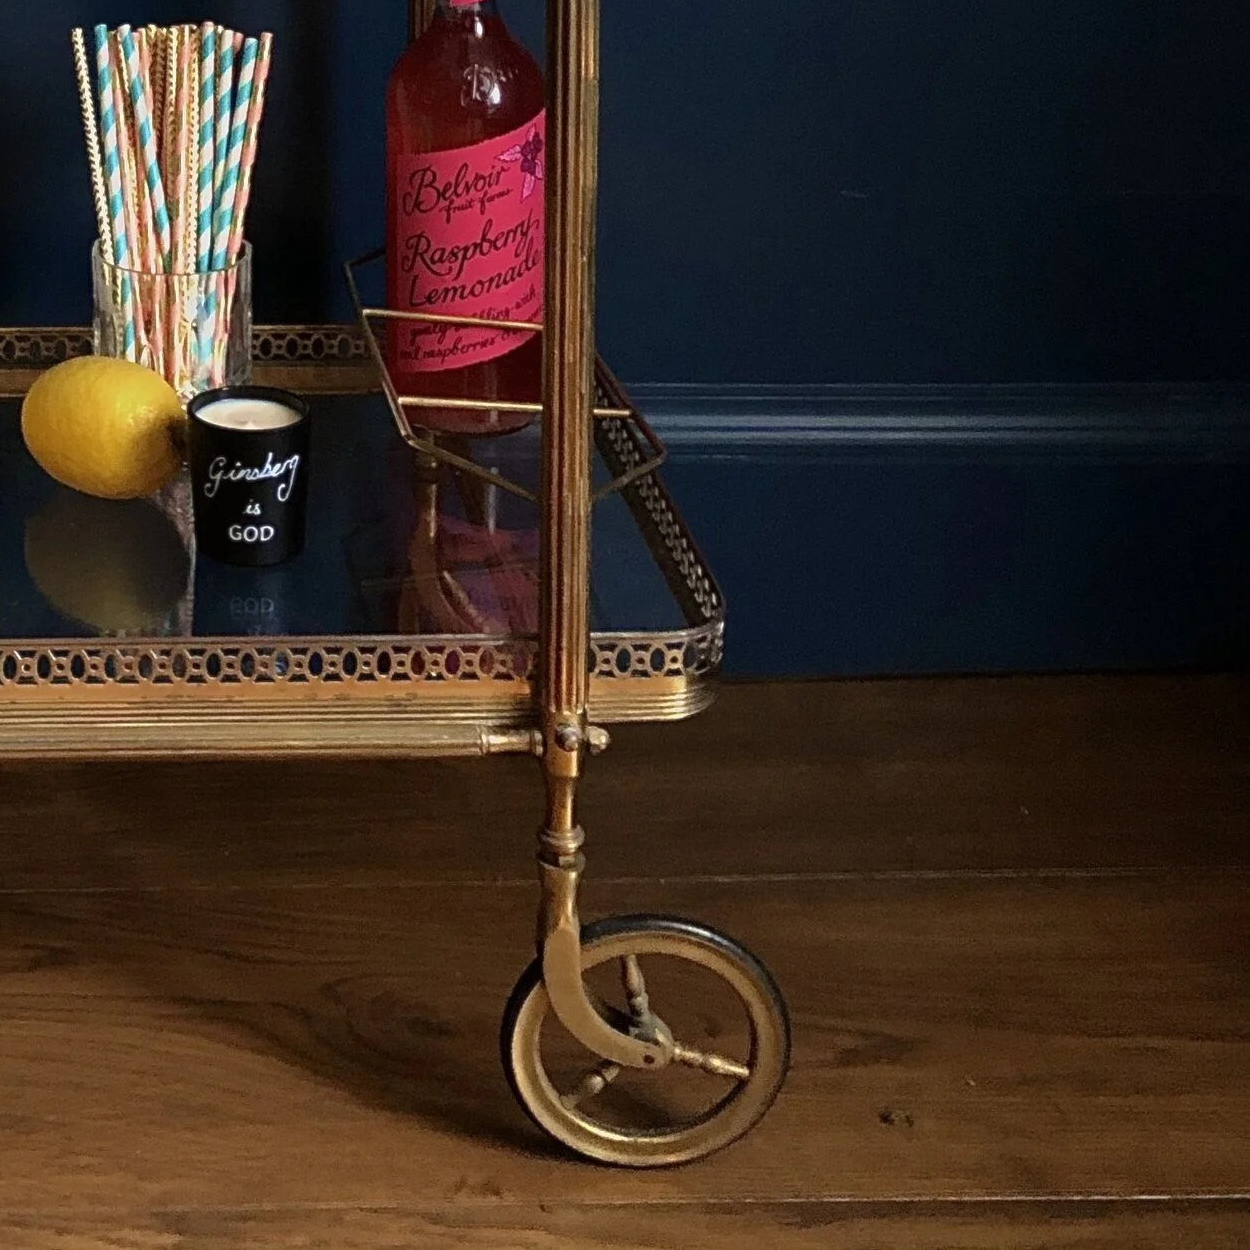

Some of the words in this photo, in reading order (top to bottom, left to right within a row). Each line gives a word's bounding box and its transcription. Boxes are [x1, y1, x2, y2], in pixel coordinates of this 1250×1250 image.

[402, 162, 511, 217] Belvoir
[438, 199, 476, 224] fruit
[477, 188, 514, 216] farms
[402, 207, 540, 281] Raspberry
[204, 451, 299, 502] Ginsberg
[242, 499, 261, 515] is
[228, 524, 275, 543] GOD
